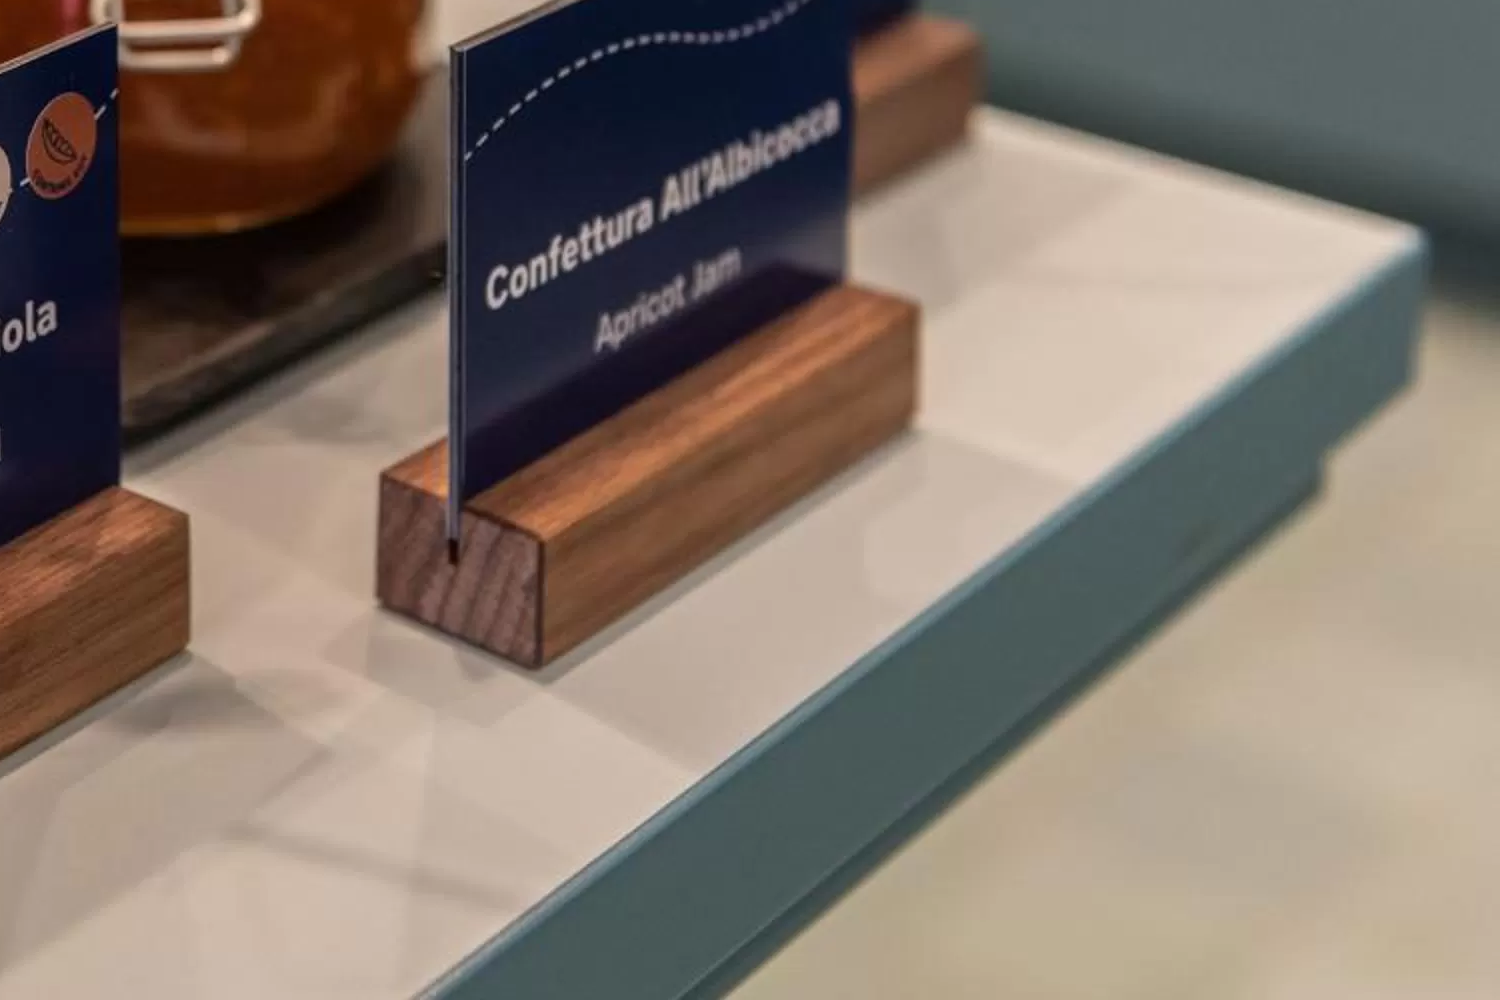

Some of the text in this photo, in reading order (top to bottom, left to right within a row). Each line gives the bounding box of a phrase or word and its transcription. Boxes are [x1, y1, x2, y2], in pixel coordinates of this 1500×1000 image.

[485, 99, 842, 310] Confettura All'Albicocca
[594, 248, 742, 354] Apricot Jam
